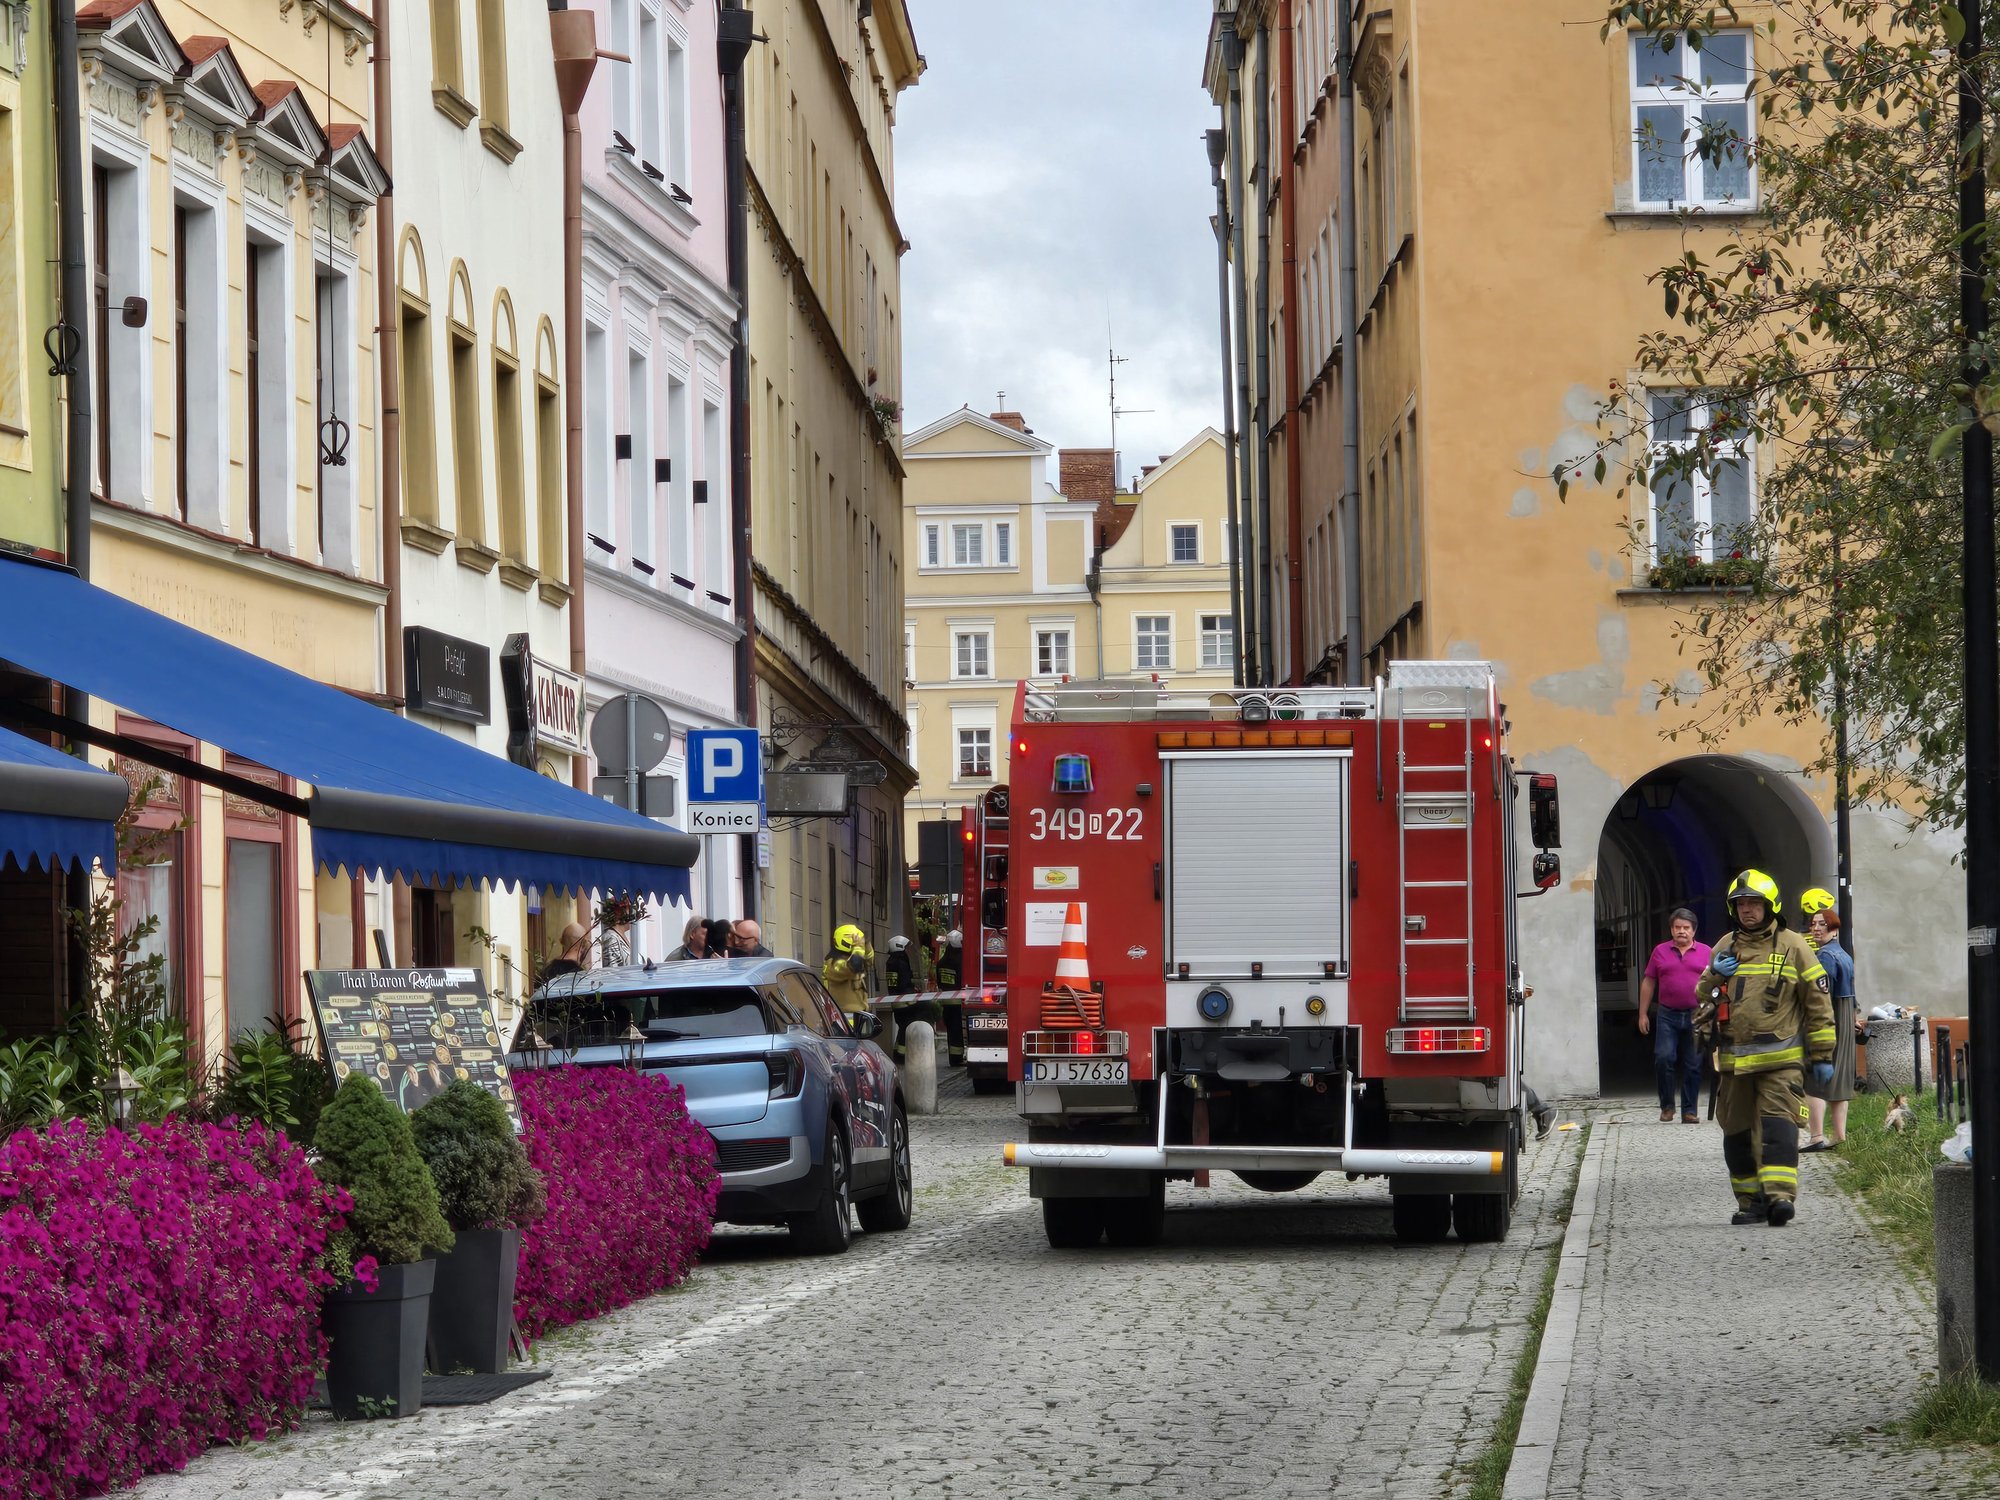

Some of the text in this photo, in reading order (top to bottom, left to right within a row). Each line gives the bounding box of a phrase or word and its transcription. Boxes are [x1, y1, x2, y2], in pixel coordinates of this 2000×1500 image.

[538, 675, 577, 736] KANTOR
[703, 738, 743, 794] P
[693, 811, 753, 826] Koniec
[338, 971, 367, 989] Thai
[370, 971, 407, 989] Baron
[973, 1019, 993, 1028] DJE
[1036, 1063, 1059, 1080] DJ
[1068, 1062, 1124, 1080] 57636
